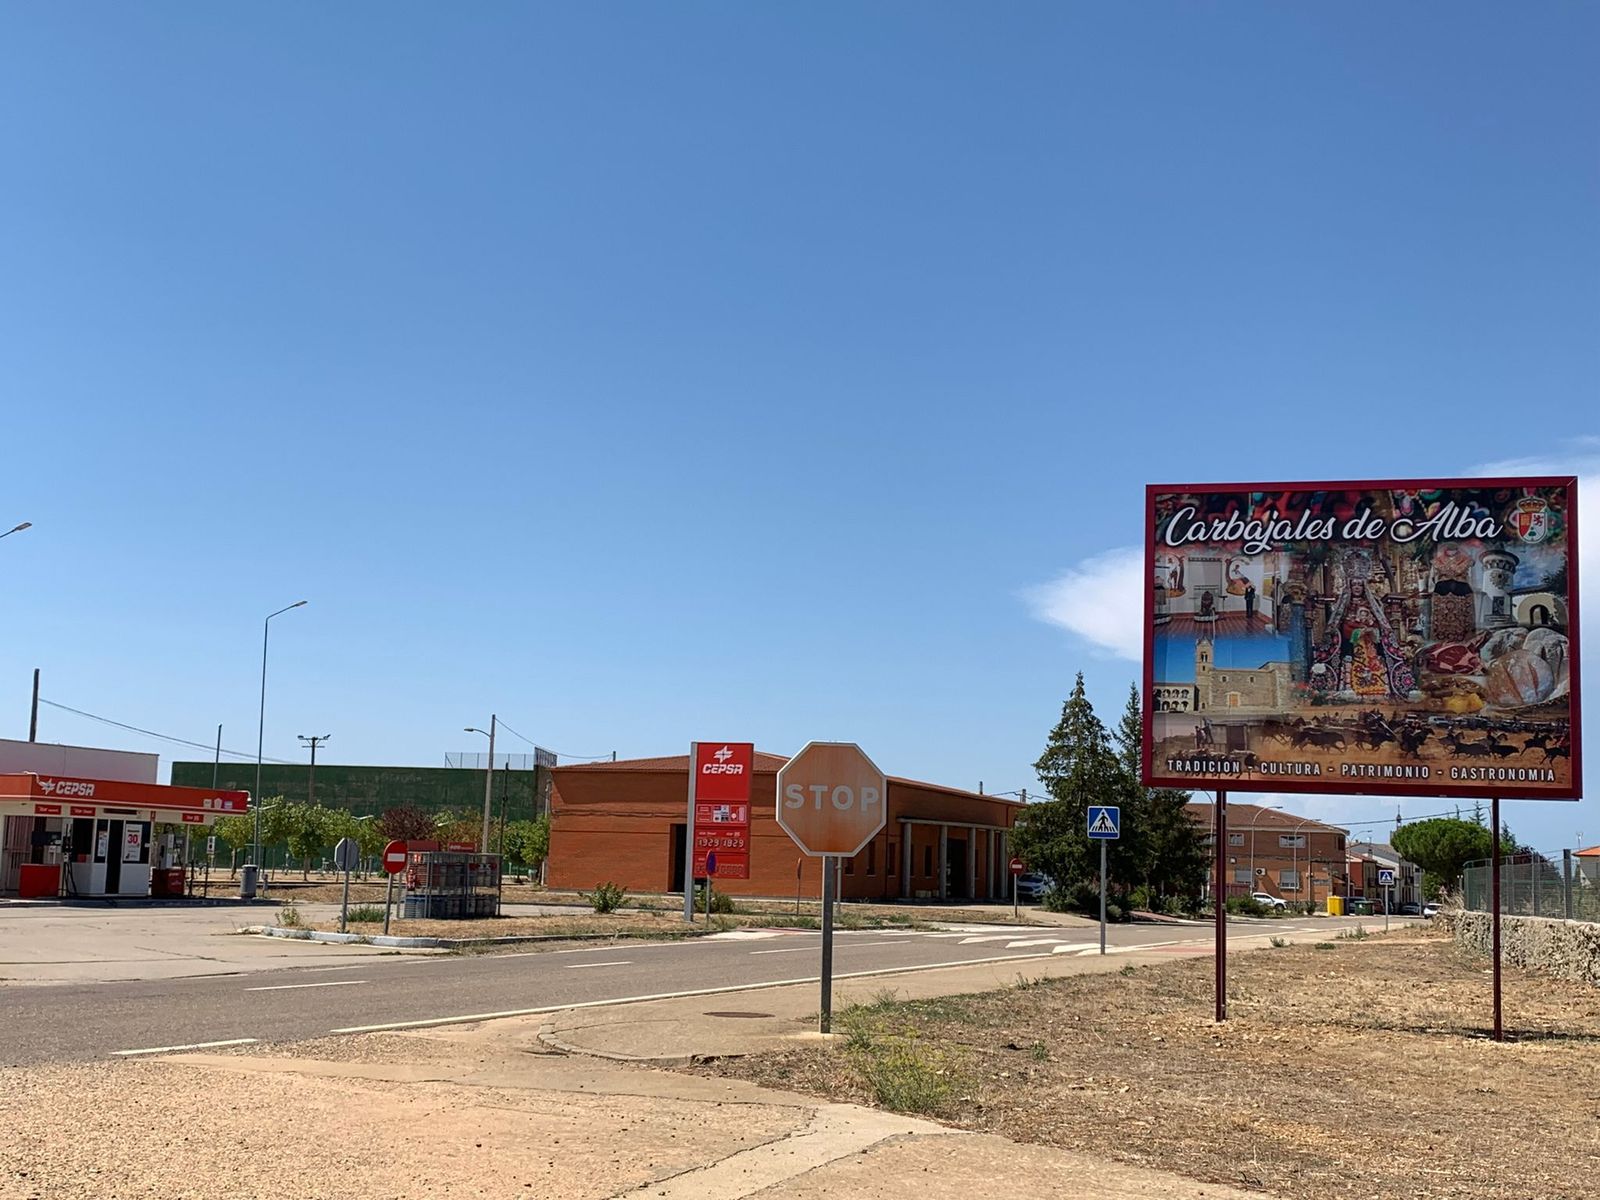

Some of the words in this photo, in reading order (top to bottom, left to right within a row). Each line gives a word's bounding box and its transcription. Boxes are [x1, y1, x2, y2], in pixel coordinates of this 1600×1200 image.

[1165, 506, 1337, 555] Carbajales
[1342, 507, 1386, 539] de
[1390, 500, 1503, 543] Alba
[702, 763, 744, 775] CEPSA
[1167, 759, 1240, 773] TRADICION
[1260, 762, 1321, 775] CULTURA
[1341, 764, 1430, 778] PATRIMONIO
[1451, 767, 1555, 782] GASTRONOMIA
[55, 781, 95, 797] CEPSA
[785, 784, 880, 812] STOP
[127, 833, 139, 844] 30
